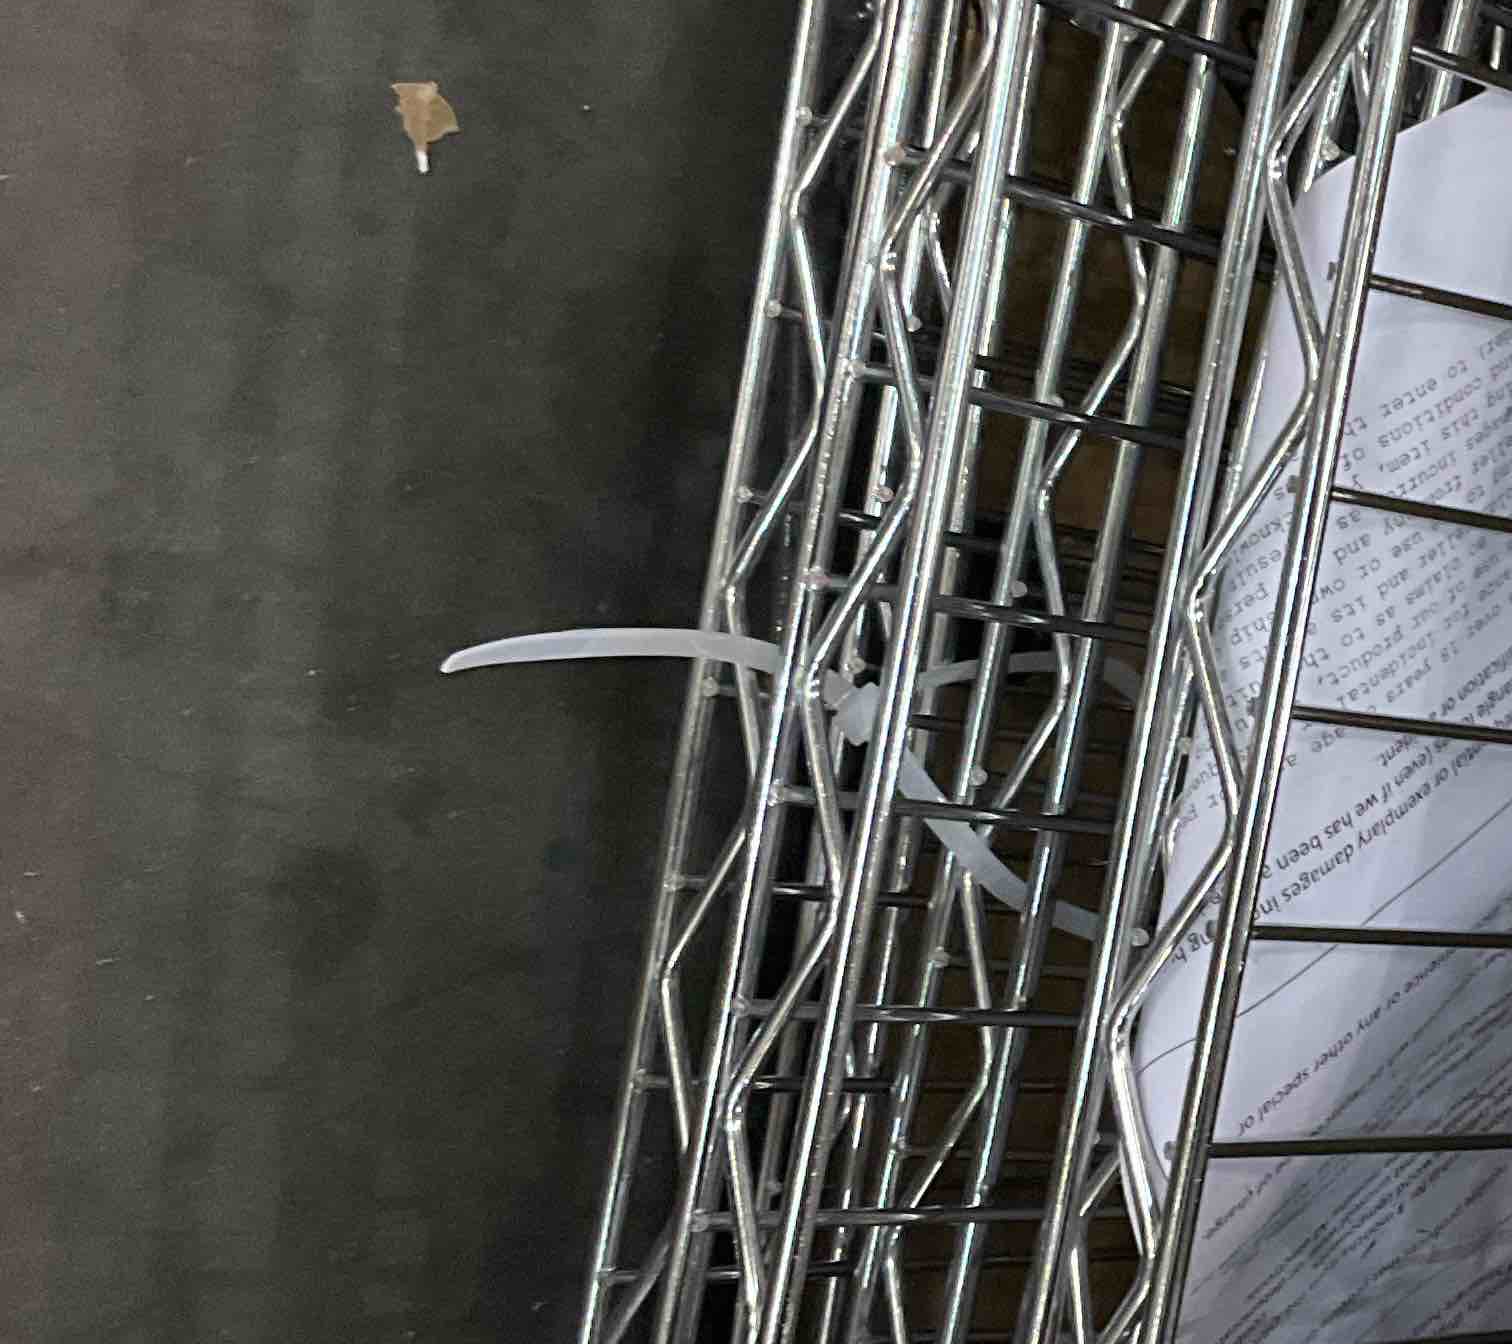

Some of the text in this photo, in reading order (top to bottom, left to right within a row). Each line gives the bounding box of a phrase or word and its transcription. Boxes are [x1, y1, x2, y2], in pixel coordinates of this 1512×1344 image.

[1442, 358, 1472, 382] to
[1374, 375, 1442, 419] enter
[1374, 373, 1487, 453] conditions
[1436, 406, 1484, 443] this
[1334, 444, 1371, 473] of
[1374, 436, 1435, 480] item,
[1332, 507, 1364, 532] as
[1330, 531, 1375, 566] and
[1354, 556, 1384, 579] or
[1373, 566, 1413, 598] and
[1327, 594, 1370, 626] its
[1371, 604, 1399, 628] as
[1336, 624, 1367, 650] to
[1313, 624, 1408, 693] product,
[1380, 657, 1436, 707] years
[1388, 744, 1438, 791] (even
[1430, 767, 1451, 787] or
[1352, 793, 1379, 818] we
[1372, 780, 1396, 803] if
[1319, 813, 1352, 841] has
[1349, 778, 1437, 851] exemplary
[1272, 833, 1325, 872] been
[1277, 841, 1359, 904] damages
[1354, 1005, 1383, 1033] any
[1307, 1029, 1357, 1074] other
[1252, 1064, 1315, 1122] special
